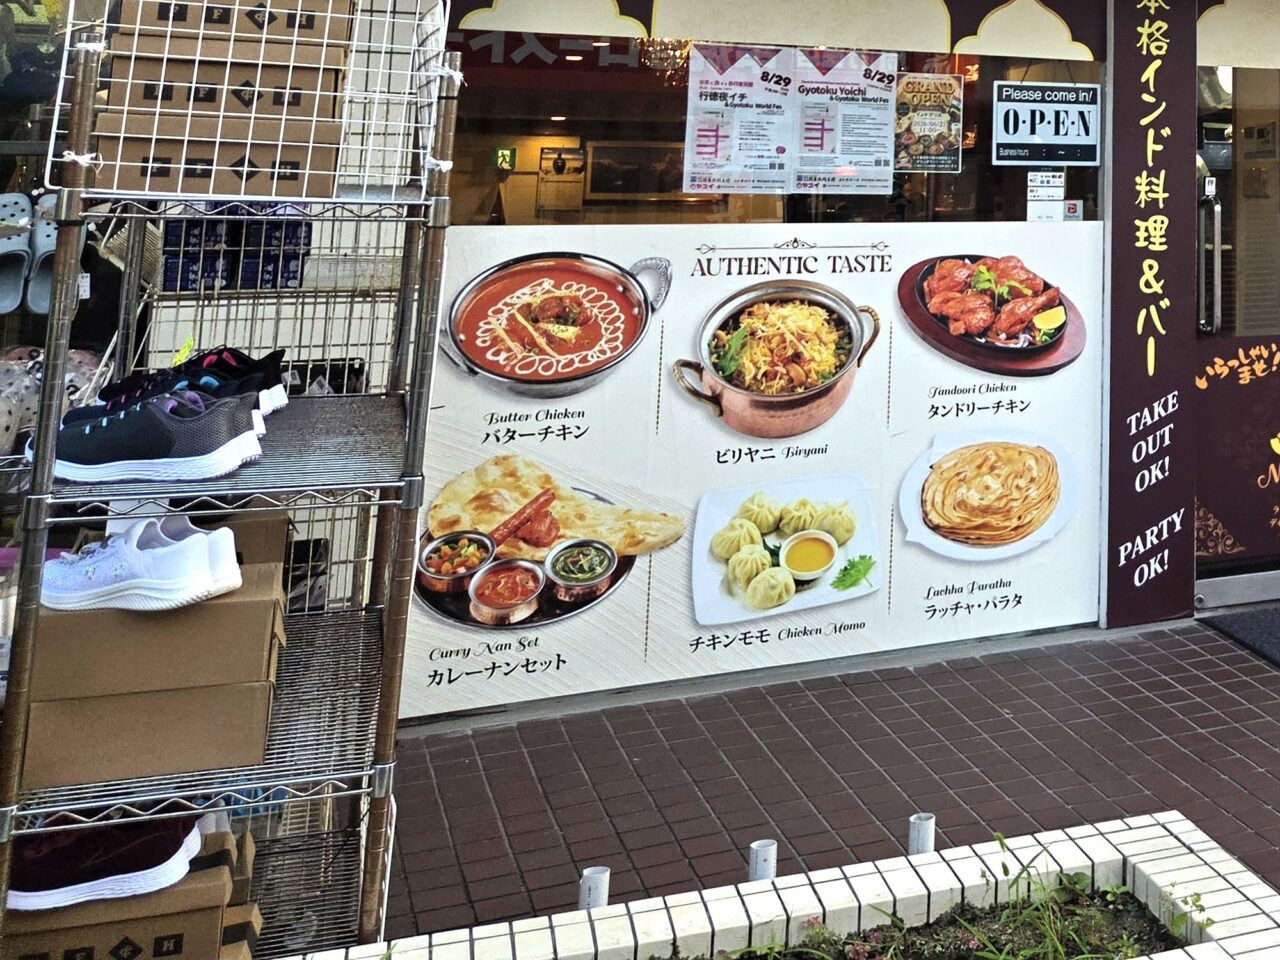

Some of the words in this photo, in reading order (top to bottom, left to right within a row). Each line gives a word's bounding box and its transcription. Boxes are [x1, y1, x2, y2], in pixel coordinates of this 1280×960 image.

[760, 71, 792, 87] 8/29
[862, 68, 895, 85] 8/29
[904, 80, 956, 94] GRAND
[798, 85, 838, 96] Gyotoku
[839, 87, 867, 96] Yoichi
[909, 94, 952, 107] OPEN
[1002, 87, 1042, 100] Please
[1045, 92, 1076, 101] come
[1079, 90, 1093, 102] in!
[690, 256, 819, 277] AUTHENTIC
[827, 254, 893, 275] TASTE
[978, 381, 1018, 395] Chicken
[484, 411, 532, 426] Butter
[535, 408, 586, 423] Chicken
[927, 399, 1032, 420] タンドリーチキン
[1127, 391, 1179, 436] TAKE
[481, 424, 591, 445] バターチキン
[1132, 424, 1174, 464] OUT
[716, 445, 776, 465] ビリヤニ
[1134, 456, 1170, 493] OK!
[1118, 508, 1186, 567] PARTY
[1133, 549, 1170, 588] OK!
[924, 593, 1023, 621] ラッチャ・パラタ
[689, 628, 771, 654] チキンモモ
[777, 625, 823, 642] Chicken
[826, 620, 866, 638] Momo
[429, 644, 471, 661] Curry
[473, 639, 512, 656] Nan
[427, 653, 568, 688] カレーナンセット
